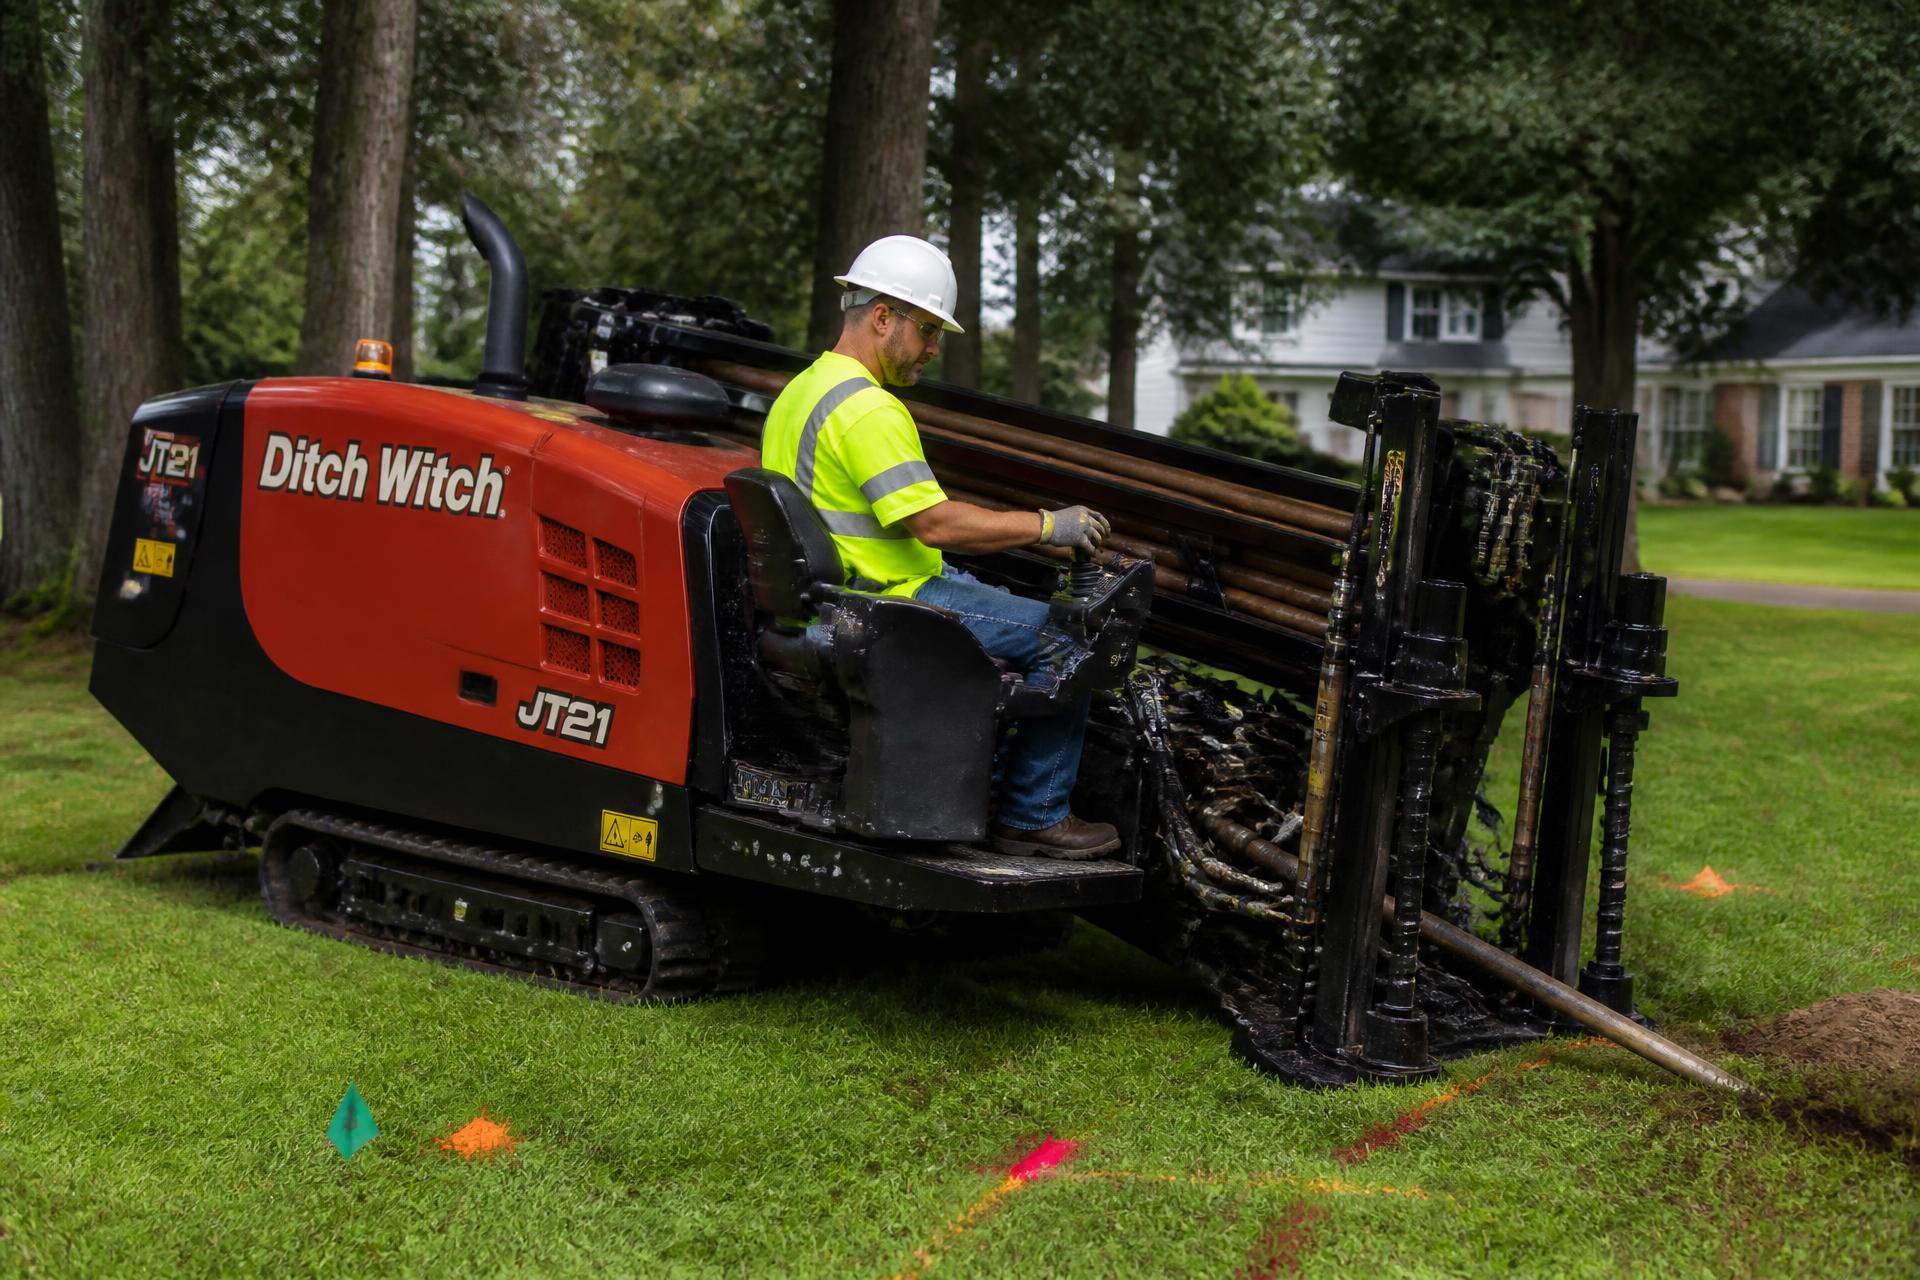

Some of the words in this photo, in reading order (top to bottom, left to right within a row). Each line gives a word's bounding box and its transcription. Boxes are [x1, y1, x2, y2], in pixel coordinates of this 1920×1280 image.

[138, 438, 201, 479] JT21
[258, 434, 369, 499] Ditch
[377, 446, 504, 516] Witch
[517, 691, 613, 745] JT21
